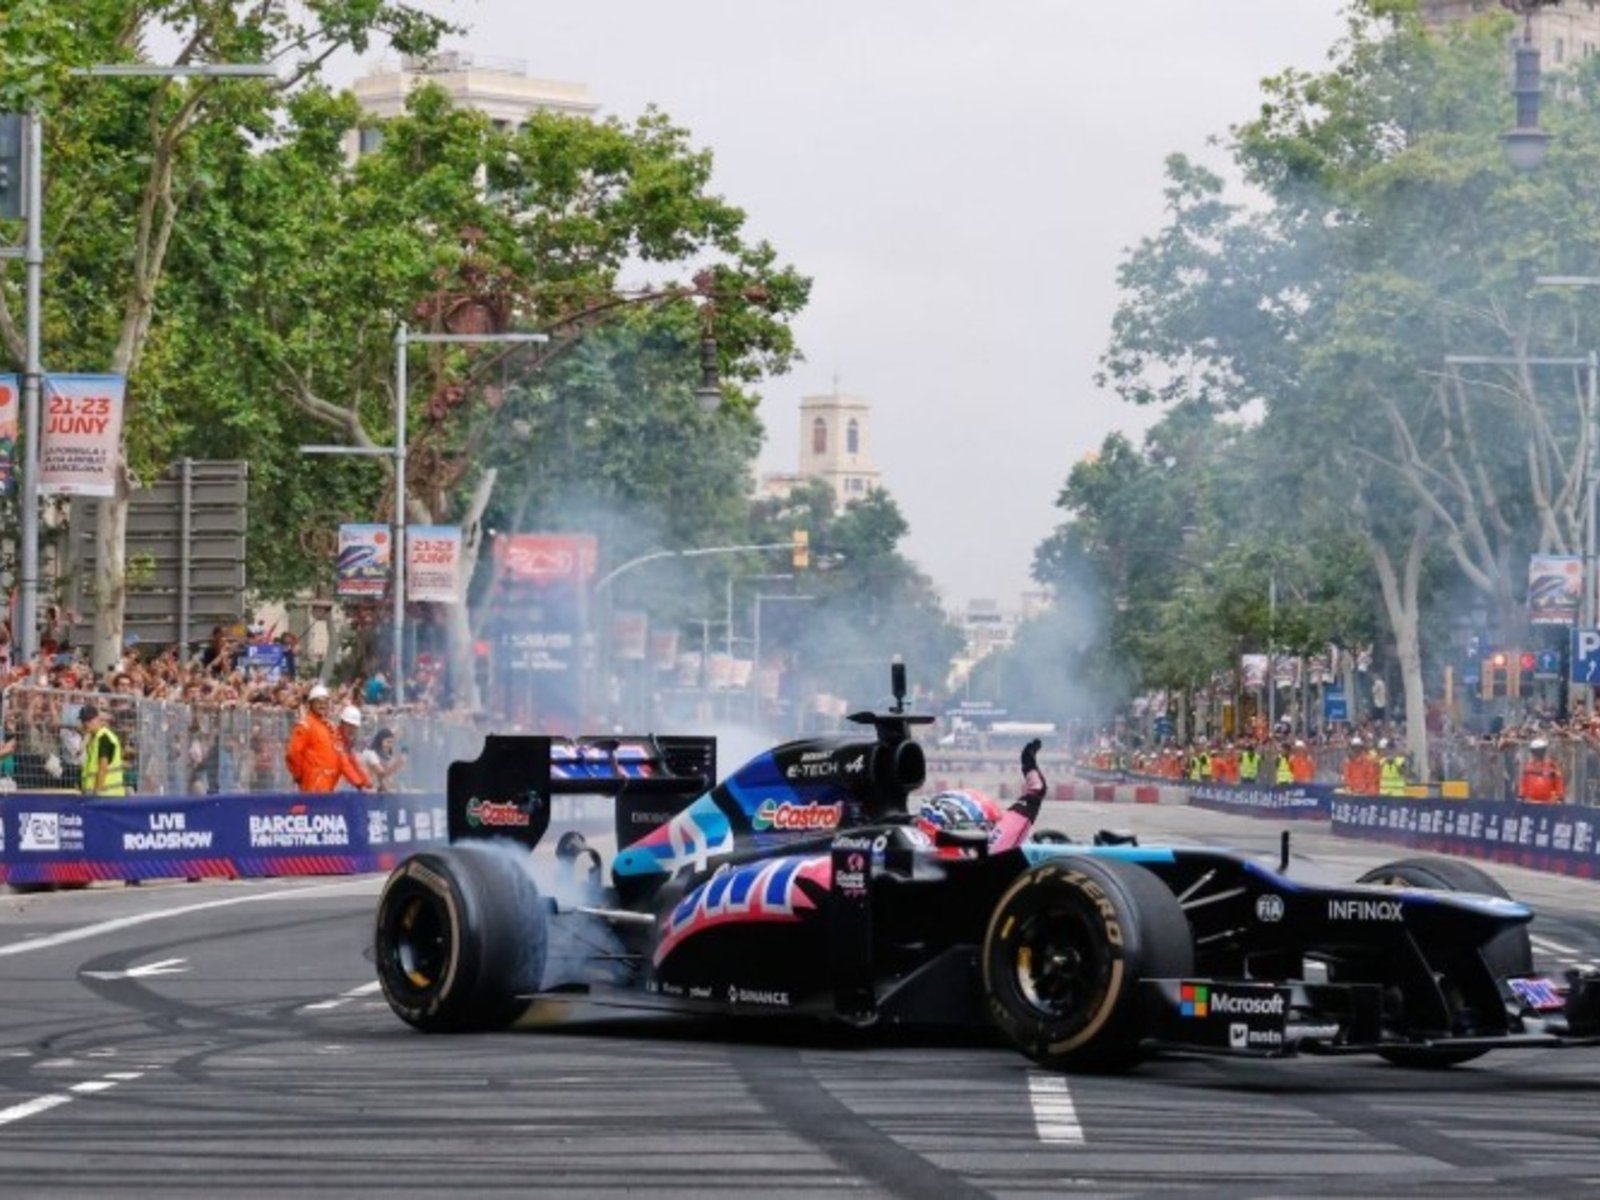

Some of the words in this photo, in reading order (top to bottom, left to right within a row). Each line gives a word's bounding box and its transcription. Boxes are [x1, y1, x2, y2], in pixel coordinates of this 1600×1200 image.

[47, 417, 109, 434] JUNY
[1579, 632, 1600, 661] P
[149, 812, 186, 830] LIVE
[773, 800, 843, 830] Castrol
[249, 815, 347, 834] BARCELONA
[123, 832, 212, 850] ROADSHOW
[250, 833, 272, 847] FAN
[1035, 868, 1057, 884] P
[1061, 869, 1124, 947] ZERO
[1328, 900, 1403, 921] INFINOX
[740, 988, 789, 1006] BINANCE
[1249, 1030, 1282, 1044] mntn
